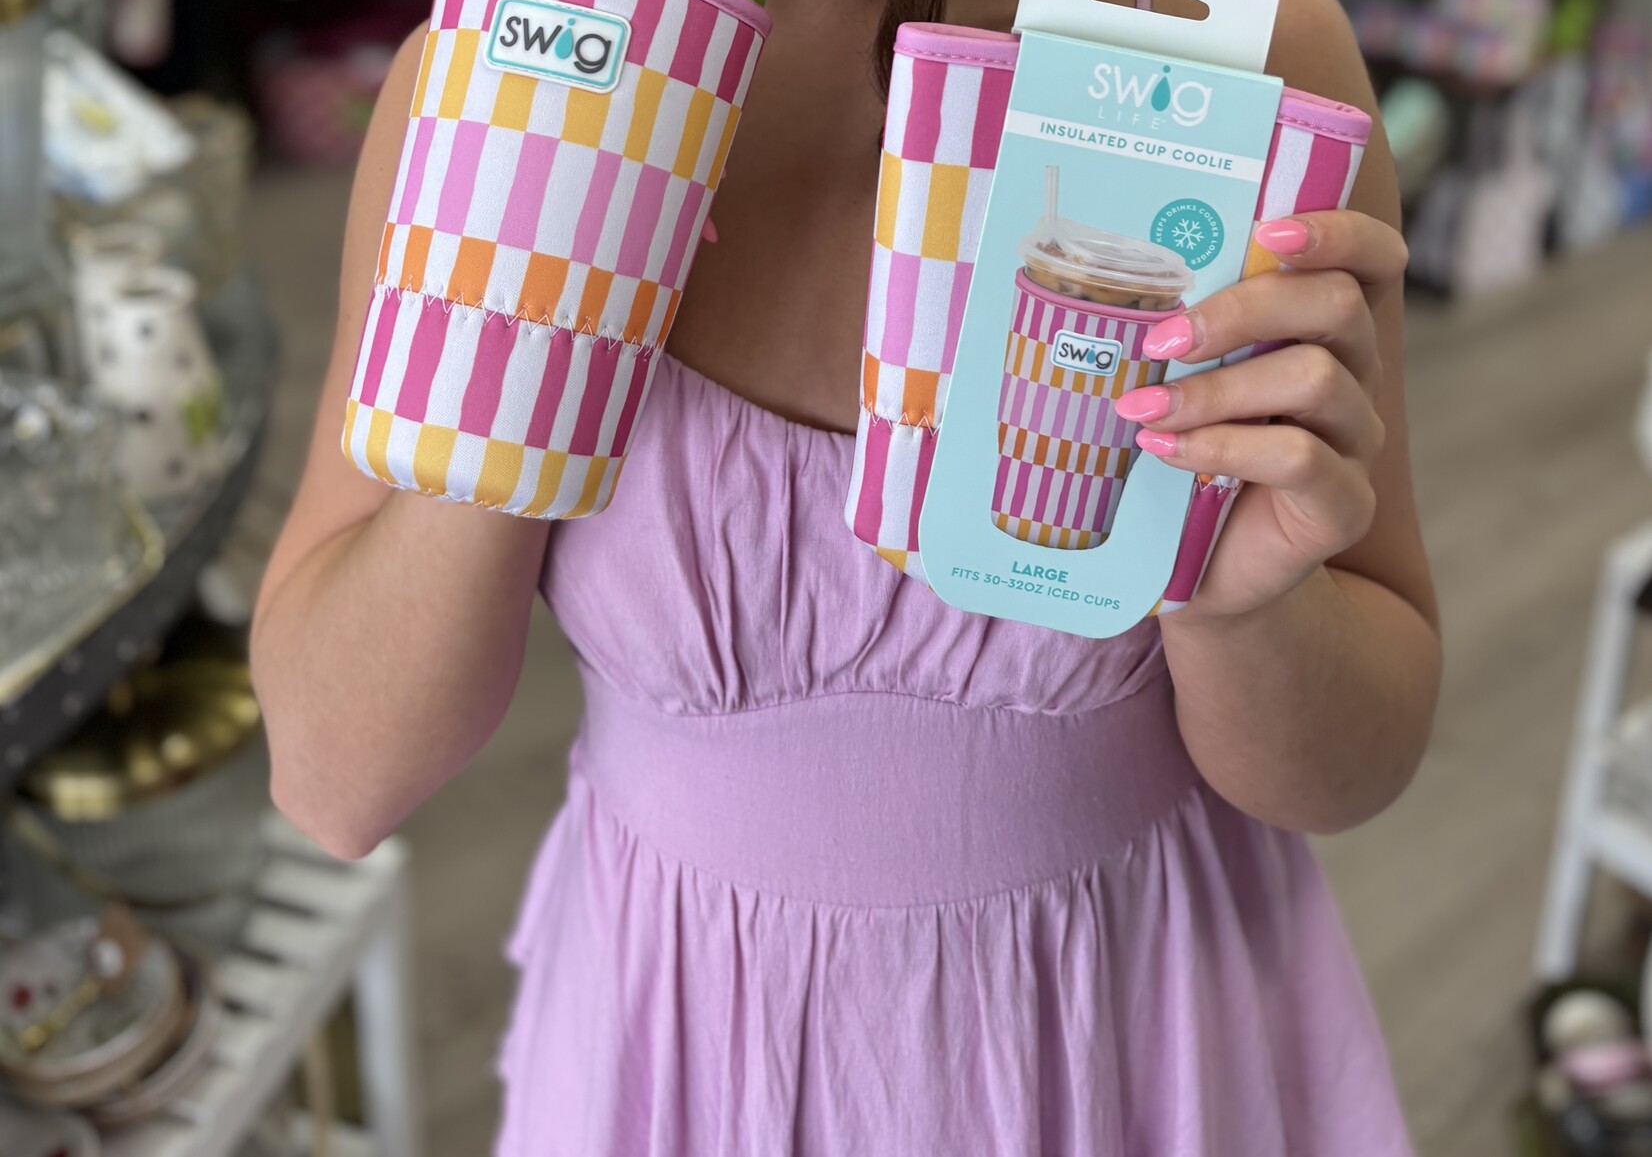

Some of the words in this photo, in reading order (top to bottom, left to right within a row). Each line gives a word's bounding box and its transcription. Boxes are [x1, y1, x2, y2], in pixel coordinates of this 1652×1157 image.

[1098, 107, 1161, 129] LIFE
[1040, 122, 1127, 149] INSULATED
[1134, 141, 1167, 157] CUP
[1172, 149, 1233, 171] COOLIE
[1166, 204, 1197, 217] DRINKS
[1198, 208, 1219, 237] COLDER
[1155, 217, 1167, 243] KEEPS
[1190, 240, 1218, 265] LONGER
[1011, 561, 1069, 583] LARGE
[951, 567, 980, 582] FITS
[1047, 586, 1080, 601] ICED
[1084, 594, 1121, 611] CUPS
